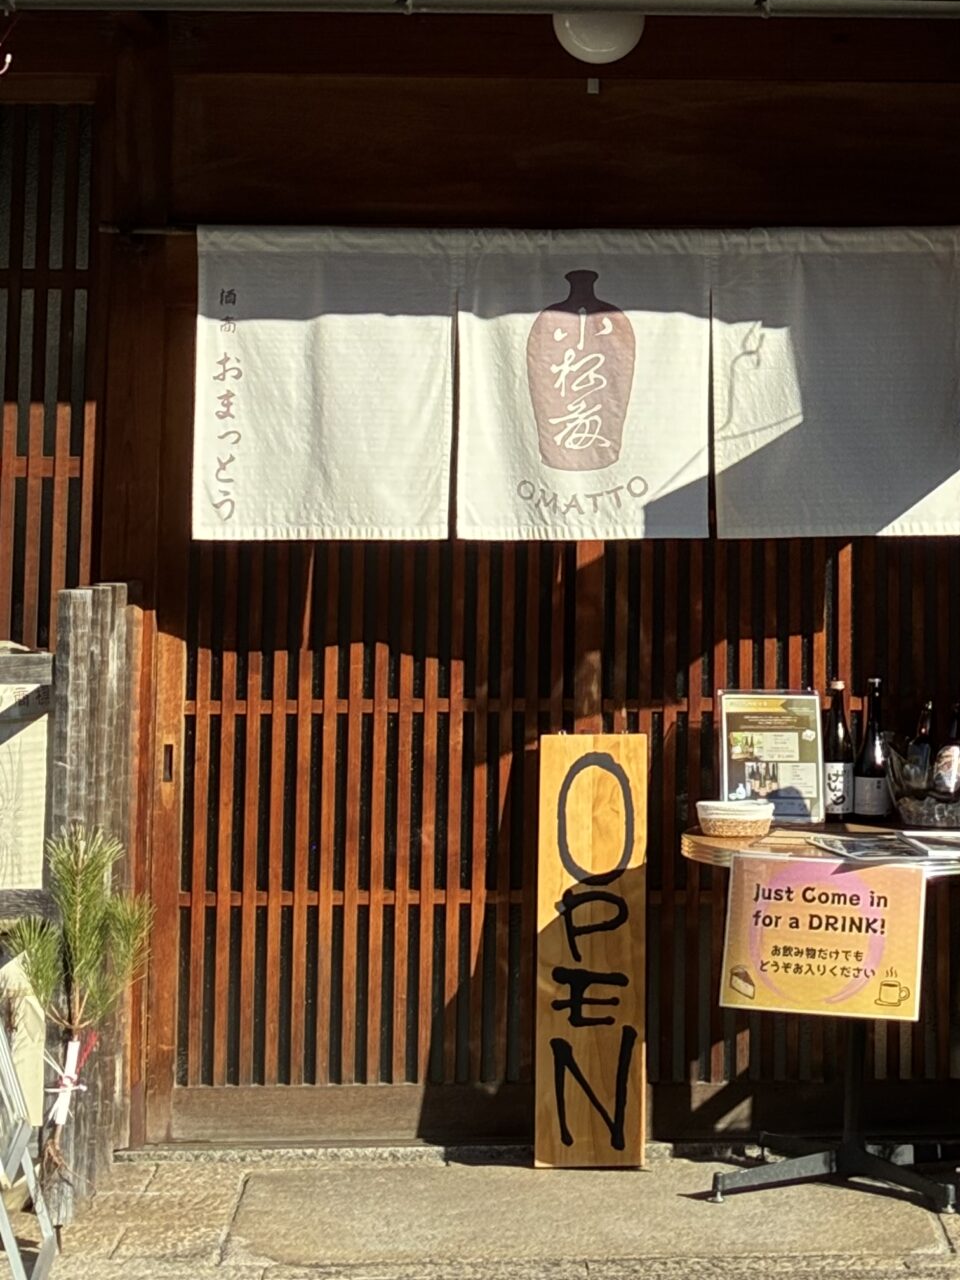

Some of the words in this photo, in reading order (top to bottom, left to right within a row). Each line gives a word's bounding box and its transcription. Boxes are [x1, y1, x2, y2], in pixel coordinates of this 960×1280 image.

[516, 475, 649, 516] OMATTO
[753, 883, 795, 903] Just
[801, 886, 861, 908] Come
[868, 890, 889, 909] in
[752, 910, 782, 930] for
[789, 916, 800, 931] a
[808, 914, 887, 936] DRINK!
[549, 751, 638, 1151] OPEN
[770, 944, 865, 962] お飲み物だけでも
[759, 960, 876, 979] どうぞお入りください
